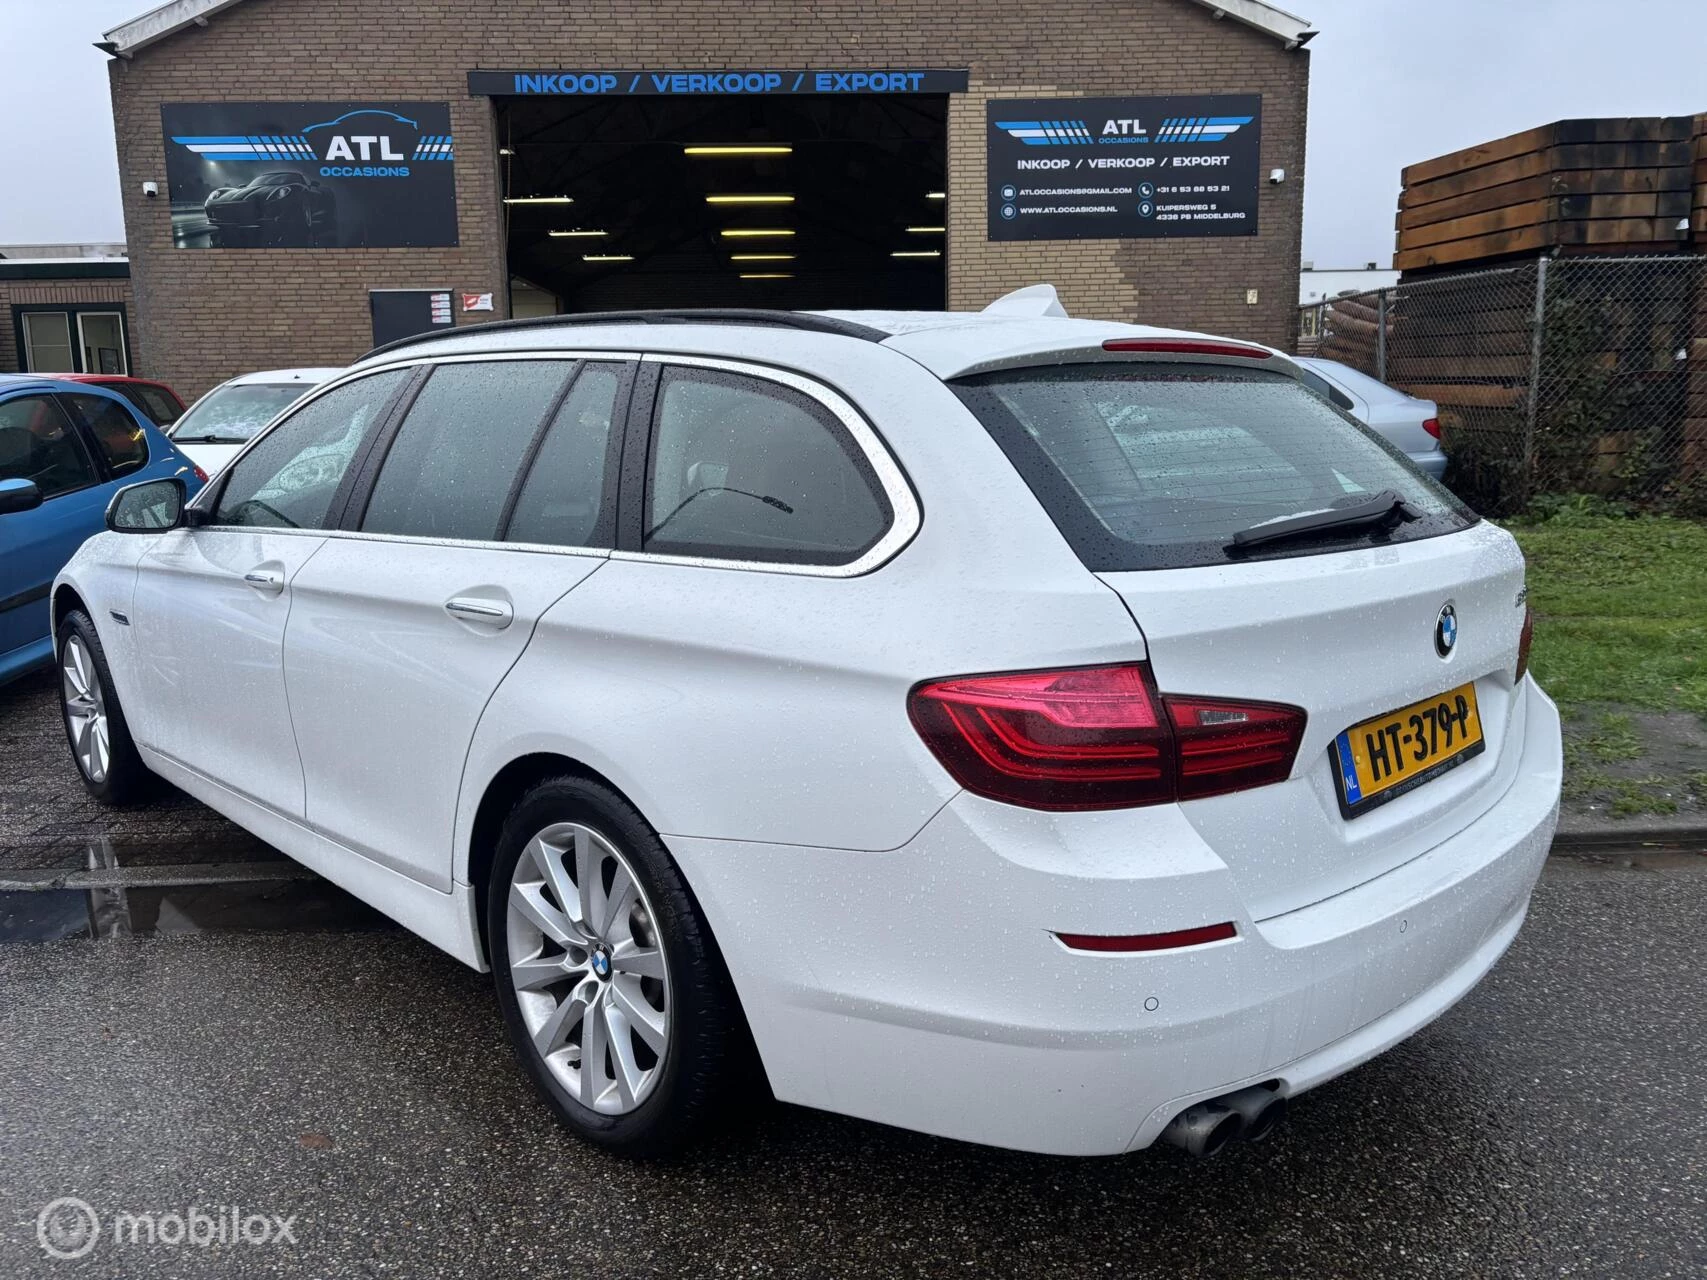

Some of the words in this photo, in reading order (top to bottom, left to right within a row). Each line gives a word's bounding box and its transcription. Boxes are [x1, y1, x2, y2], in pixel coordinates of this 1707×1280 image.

[514, 73, 617, 94] INKOOP
[628, 74, 641, 93] /
[651, 73, 782, 93] VERKOOP
[791, 73, 805, 92] /
[815, 72, 925, 92] EXPORT
[1102, 119, 1147, 135] ATL
[1098, 136, 1149, 144] OCCASIONS
[325, 135, 404, 161] ATL
[1017, 159, 1070, 170] INKOOP
[1075, 159, 1083, 169] /
[1087, 157, 1156, 169] VERKOOP
[1159, 157, 1169, 168] /
[1172, 155, 1231, 167] EXPORT
[319, 166, 410, 177] OCCASIONS
[1019, 205, 1119, 214] WWW.ATLOCCASIONS.NL
[1156, 204, 1209, 212] KUIPERSWEG
[1193, 211, 1246, 220] MIDDELBURG
[1366, 694, 1468, 783] HT-379-P
[1345, 776, 1358, 793] NL
